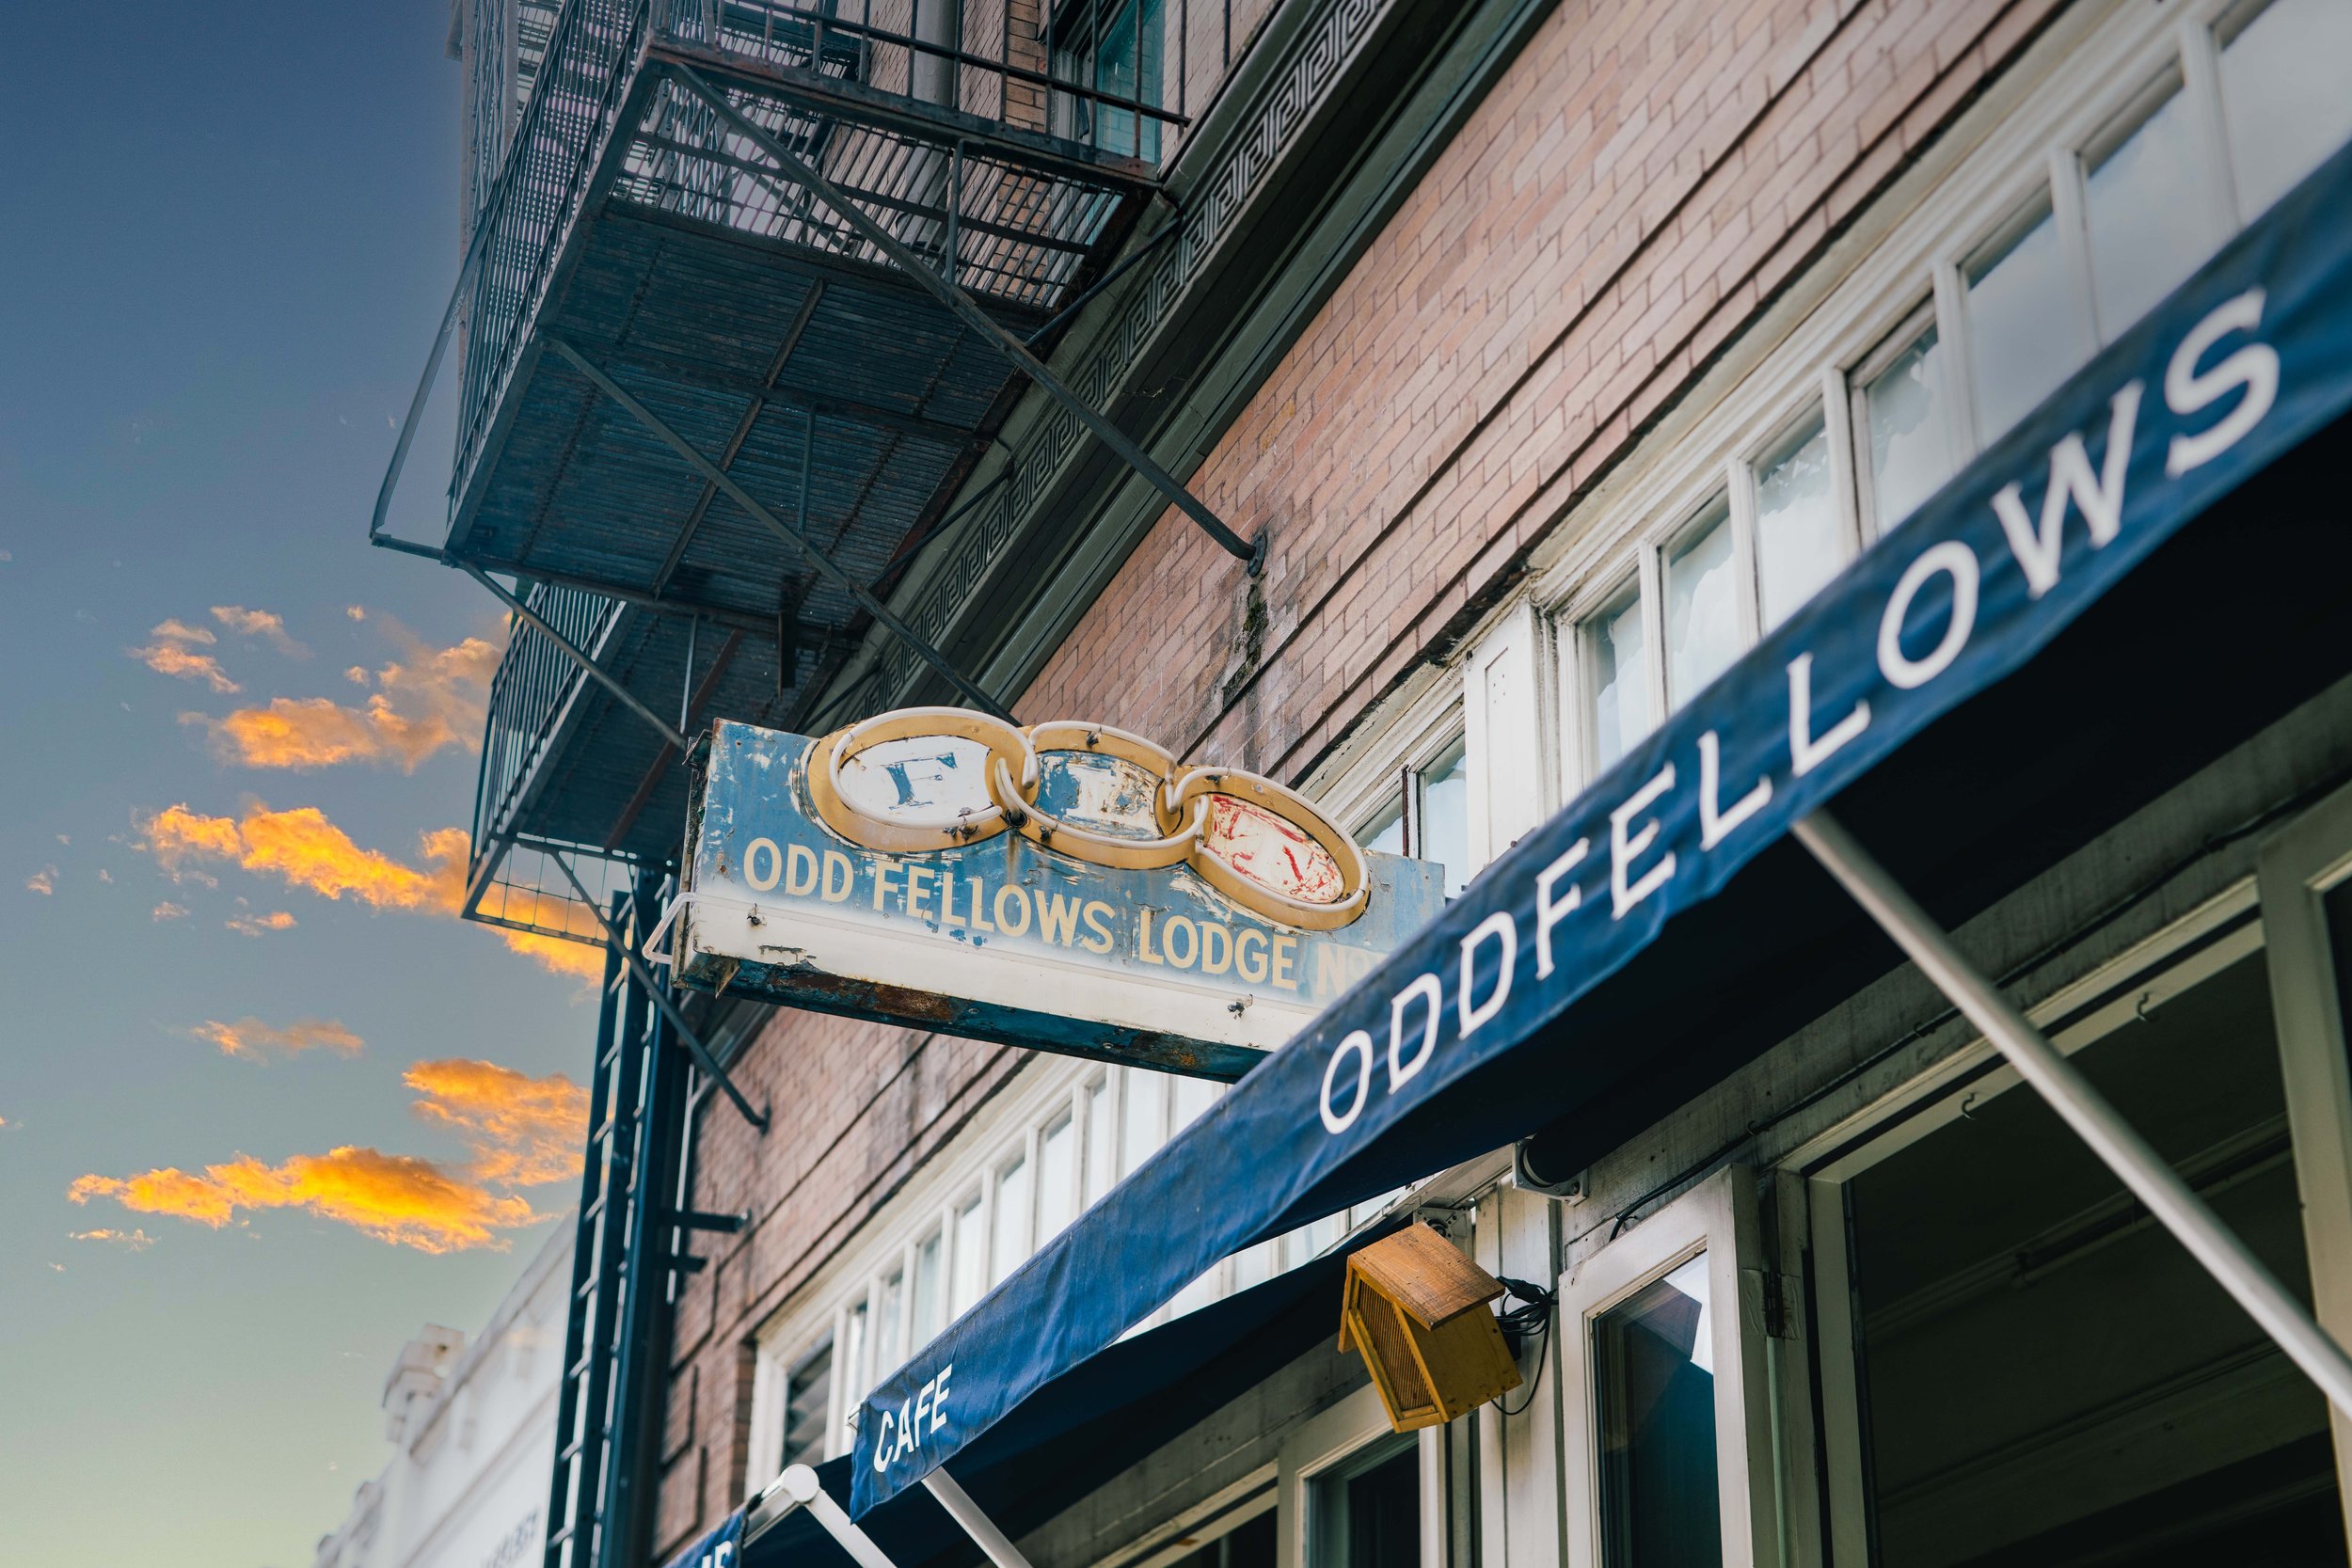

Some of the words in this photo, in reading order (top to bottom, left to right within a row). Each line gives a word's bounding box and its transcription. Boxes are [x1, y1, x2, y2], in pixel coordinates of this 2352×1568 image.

[1319, 289, 2280, 1135] ODDFELLOWS
[743, 837, 854, 903] ODD
[873, 861, 1115, 955] FELLOWS
[1137, 909, 1297, 990] LODGE
[873, 1363, 952, 1472] CAFE
